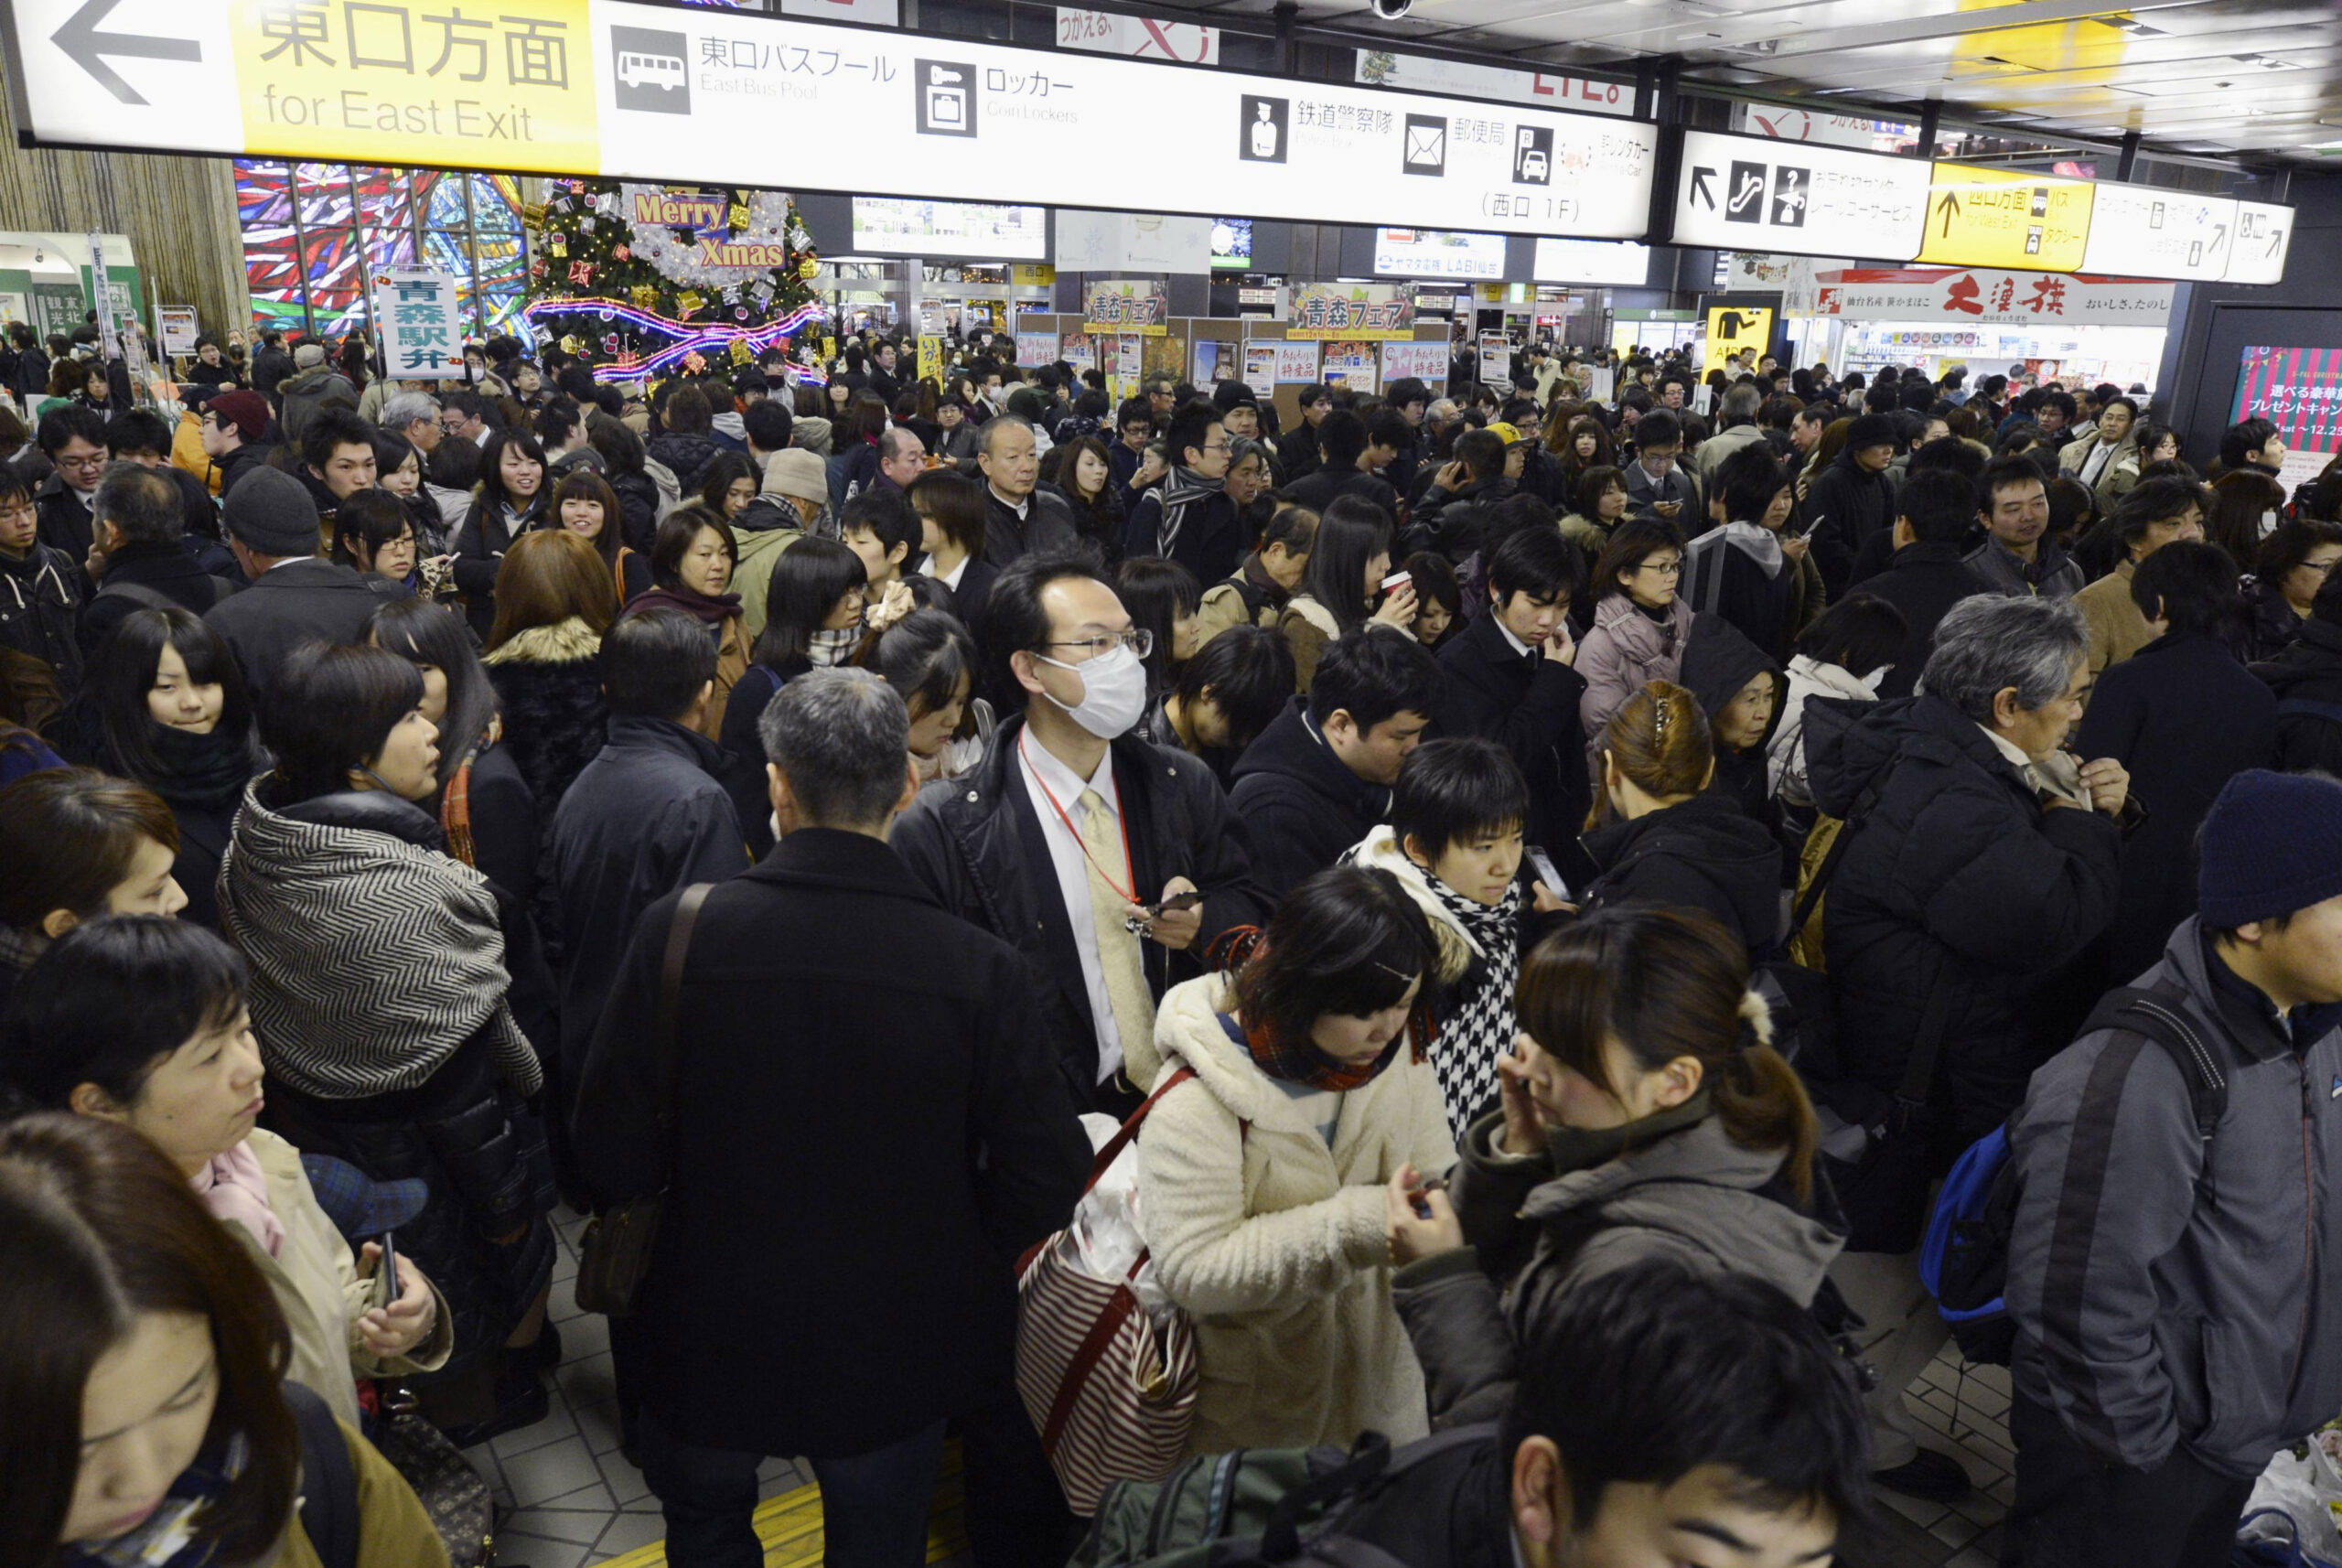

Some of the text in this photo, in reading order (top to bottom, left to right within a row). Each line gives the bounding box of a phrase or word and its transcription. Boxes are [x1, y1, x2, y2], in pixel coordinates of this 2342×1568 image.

[261, 0, 569, 91] 東口方面
[699, 36, 897, 84] 東口バスプール
[701, 73, 819, 101] East Bus Pool
[986, 67, 1075, 97] ロッカー
[263, 84, 533, 143] for East Exit
[986, 101, 1079, 124] Coin Lockers
[1296, 99, 1394, 134] 鉄道警察隊
[1453, 116, 1506, 147] 郵便局
[635, 194, 725, 231] Merry
[1482, 191, 1580, 223] (西口 1F)
[698, 237, 786, 268] Xmas
[1025, 265, 1045, 278] 西口
[64, 295, 82, 325] 東北
[1093, 292, 1160, 325] 青森フェア
[1846, 295, 1884, 308] 仙台名産
[1943, 274, 2066, 316] 大漁旗
[392, 280, 450, 370] 青森駅弁
[1305, 295, 1406, 331] 青森フェア
[1283, 349, 1316, 360] あおもりの
[1415, 347, 1448, 359] あおもりの
[1282, 362, 1316, 378] 特産品
[1413, 362, 1445, 376] 特産品
[2249, 399, 2342, 416] プレゼントキャン
